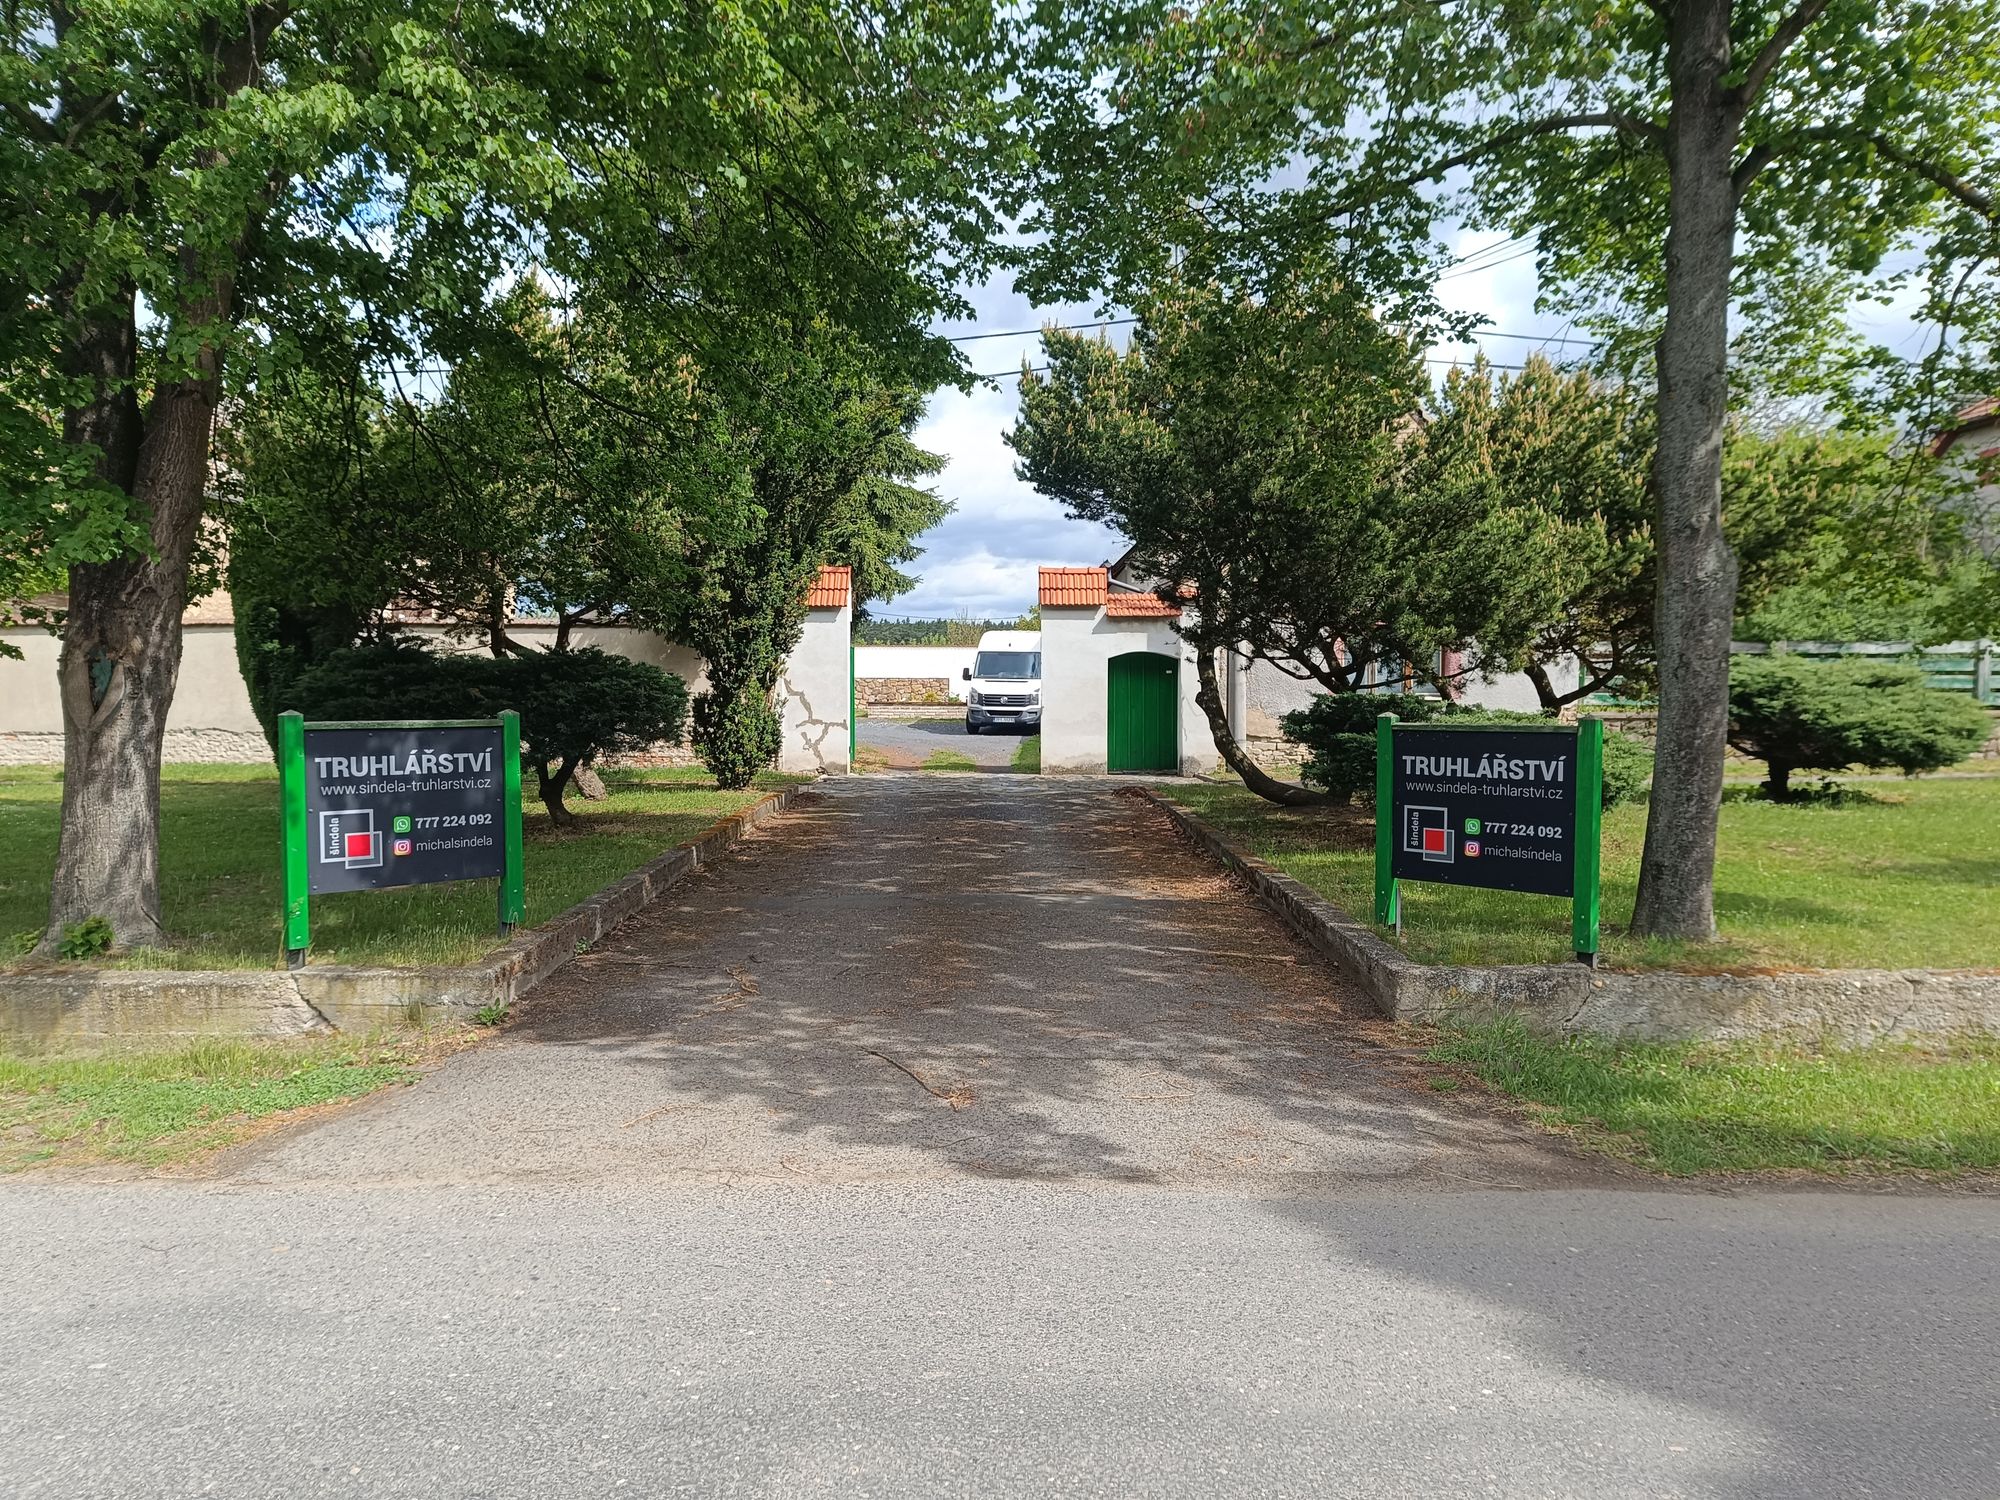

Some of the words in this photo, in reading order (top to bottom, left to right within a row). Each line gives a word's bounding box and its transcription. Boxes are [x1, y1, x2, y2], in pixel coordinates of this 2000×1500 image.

[314, 747, 493, 779] TRUHLÁŘSTVÍ
[1402, 753, 1567, 782] TRUHLÁŘSTVÍ
[320, 777, 492, 796] www.sindela-truhlarstvi.cz
[1406, 780, 1563, 800] www.sindela-truhlarstvi.cz
[415, 816, 440, 829] 777
[442, 815, 467, 828] 224
[469, 813, 492, 825] 092
[1484, 822, 1508, 834] 777
[1510, 824, 1535, 836] 224
[1537, 825, 1563, 839] 092
[416, 835, 493, 851] michalsindela
